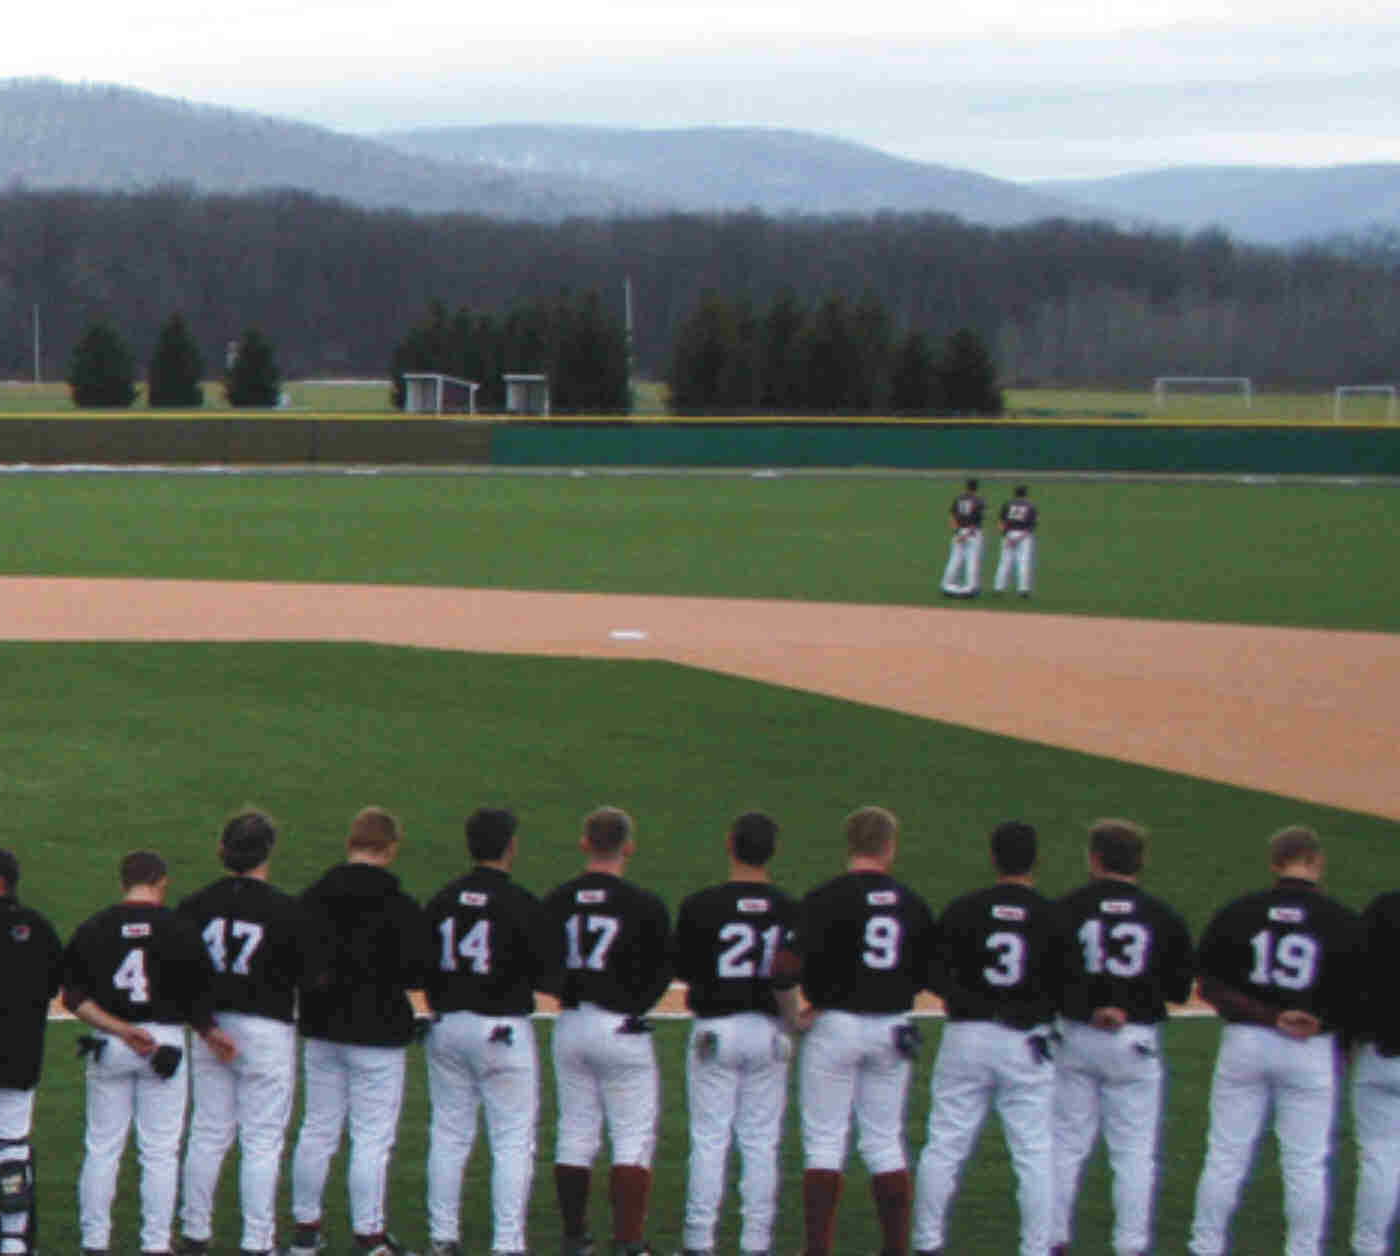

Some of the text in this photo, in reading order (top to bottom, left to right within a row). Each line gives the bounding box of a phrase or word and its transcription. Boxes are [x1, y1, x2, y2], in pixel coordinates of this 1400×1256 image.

[439, 917, 490, 974] 14
[566, 914, 619, 970] 17
[718, 923, 780, 978] 21
[862, 916, 900, 969] 9
[984, 932, 1024, 986] 3
[1250, 930, 1317, 989] 19
[113, 948, 149, 1003] 4
